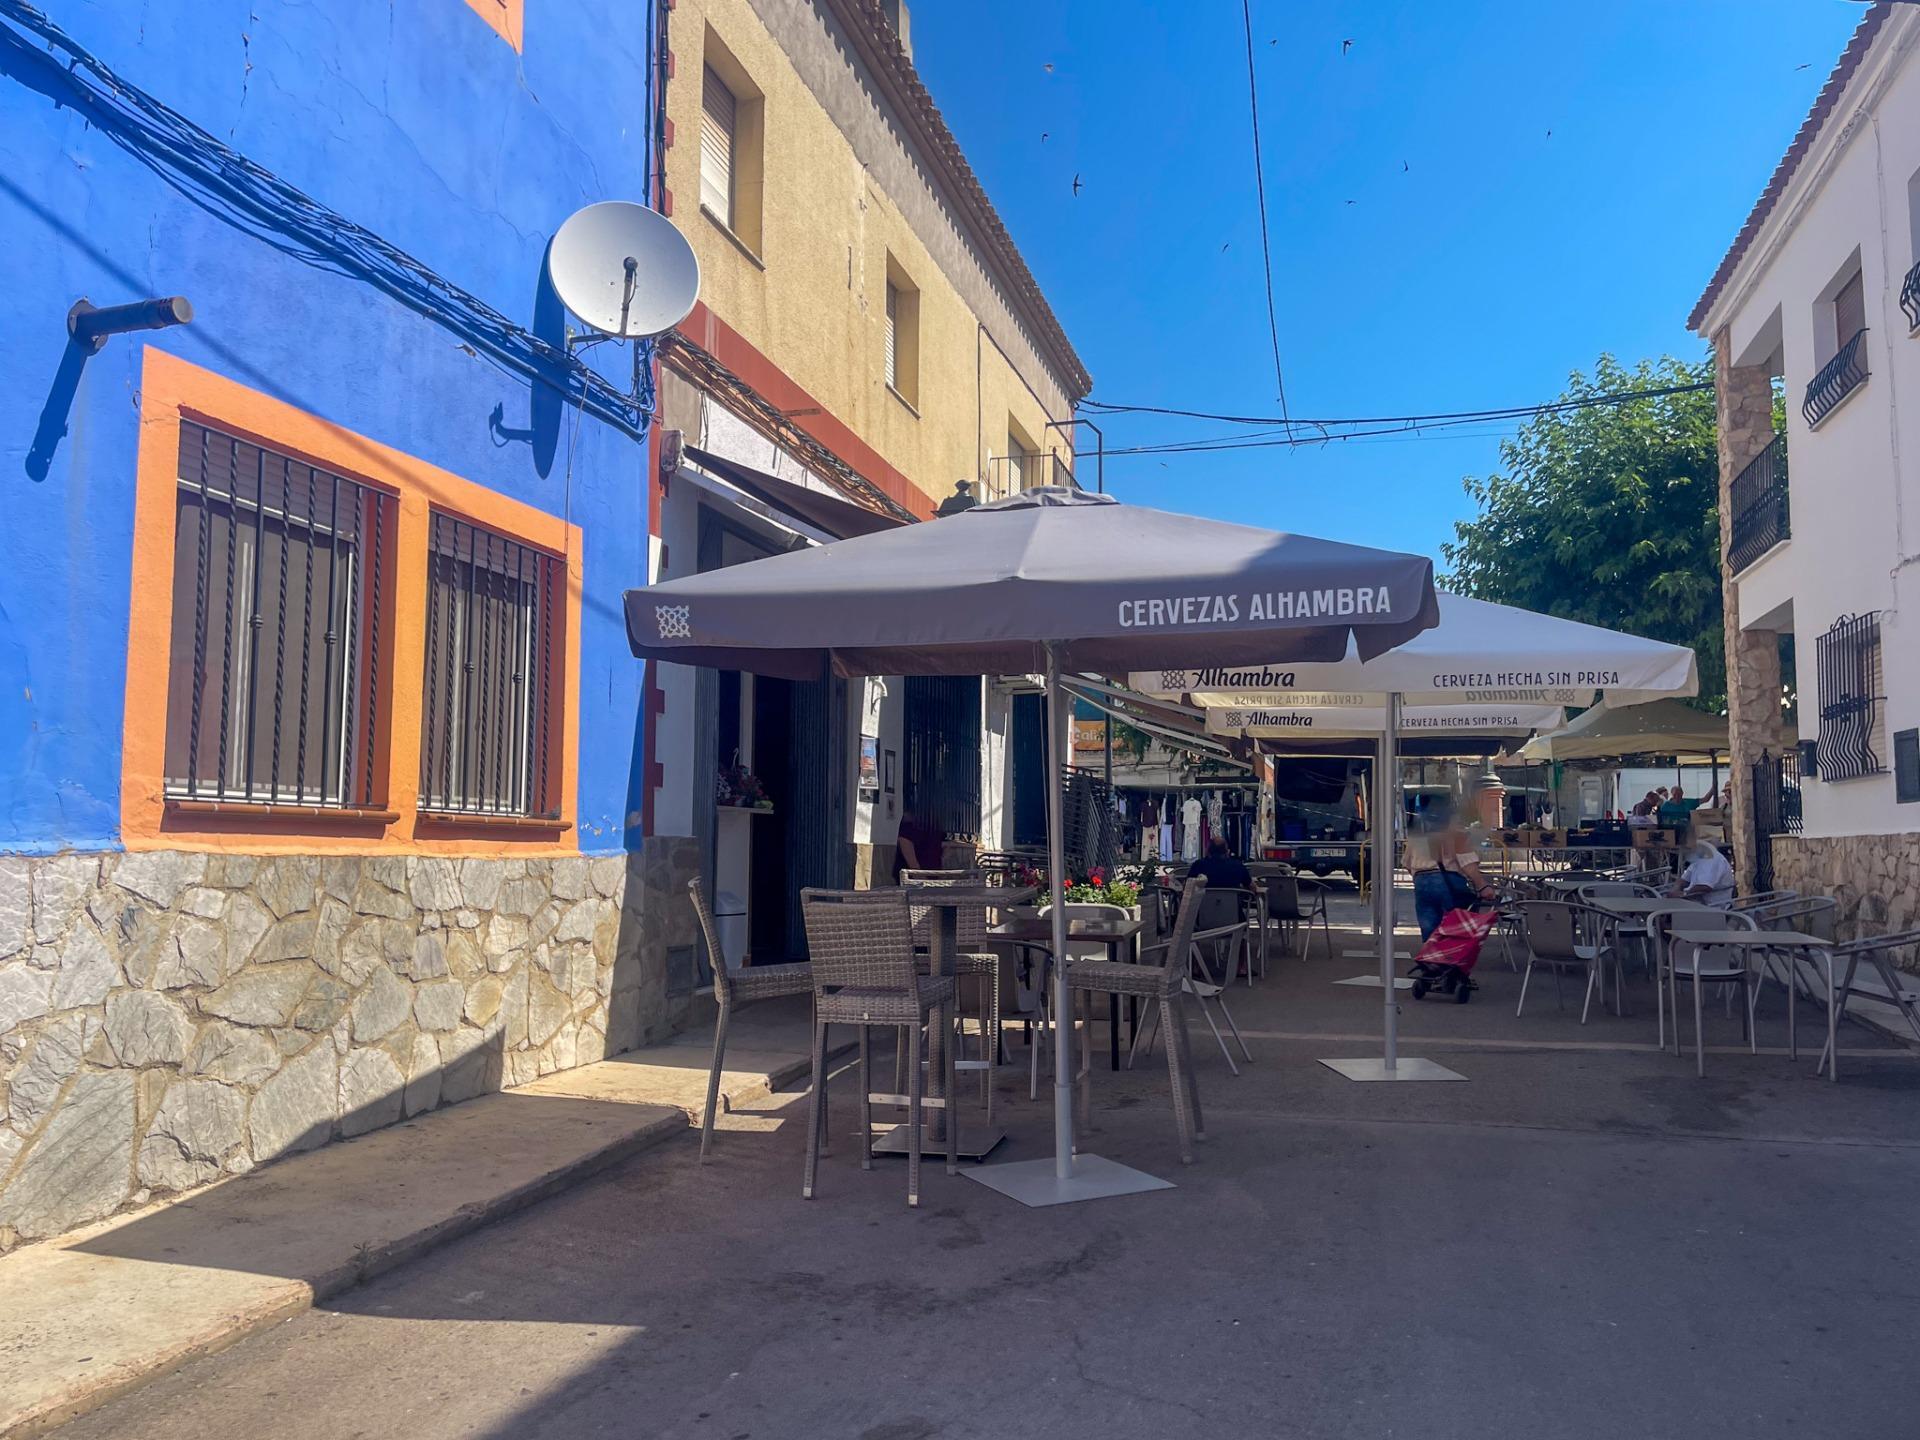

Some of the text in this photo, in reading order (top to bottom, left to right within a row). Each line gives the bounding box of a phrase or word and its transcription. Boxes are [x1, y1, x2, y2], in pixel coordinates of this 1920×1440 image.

[1118, 586, 1391, 627] CERVEZAS ALHAMBRA
[1192, 666, 1295, 688] Alhambra
[1433, 672, 1619, 687] CERVEZA HECHA SIN PRISA
[1246, 711, 1312, 727] Alhambra
[1401, 716, 1518, 727] CERVEZA HECHA SIN PRISA
